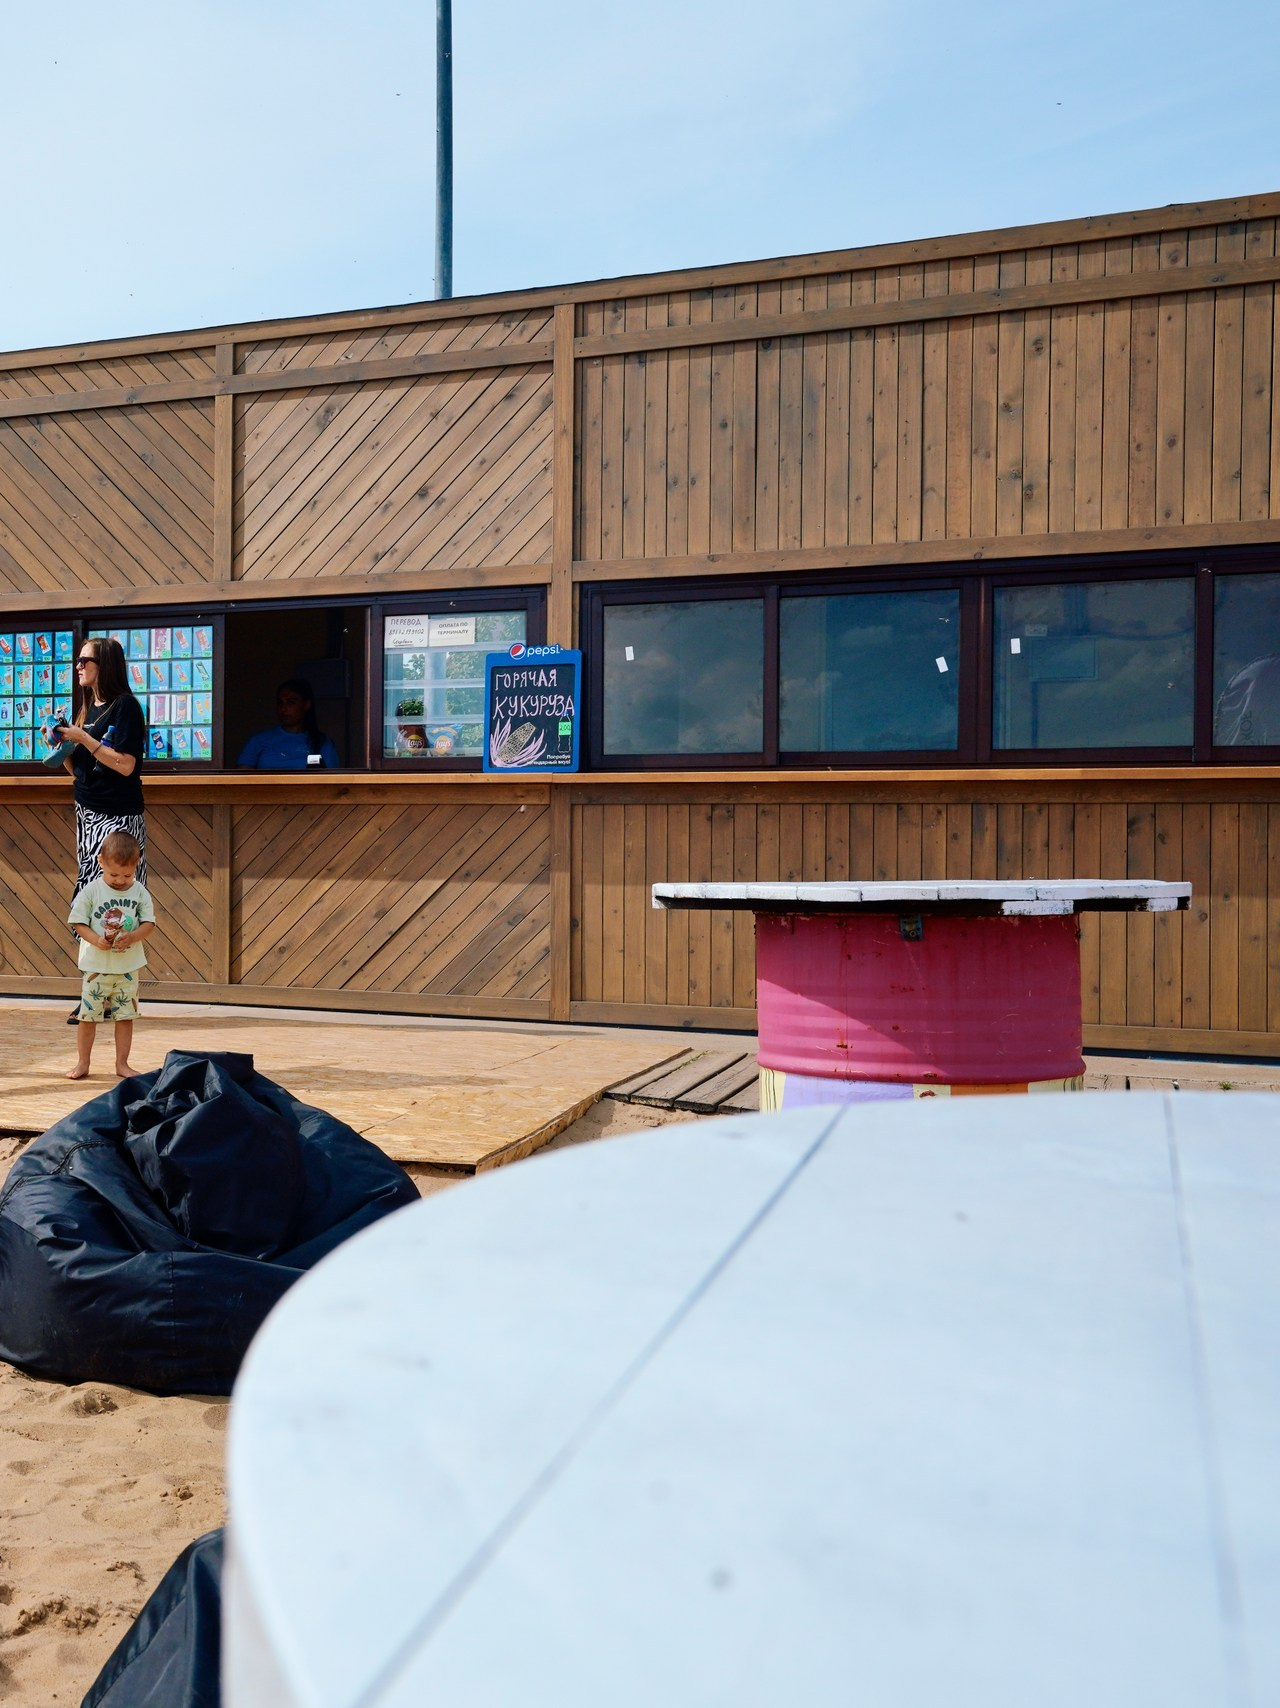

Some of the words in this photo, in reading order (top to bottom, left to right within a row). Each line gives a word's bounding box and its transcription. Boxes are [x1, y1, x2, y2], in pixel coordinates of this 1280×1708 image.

[390, 618, 421, 626] ПЕРЕВОД
[527, 644, 560, 657] pepsi
[495, 668, 557, 691] ГОРЯЧАЯ
[492, 694, 575, 719] КУКУРУЗА
